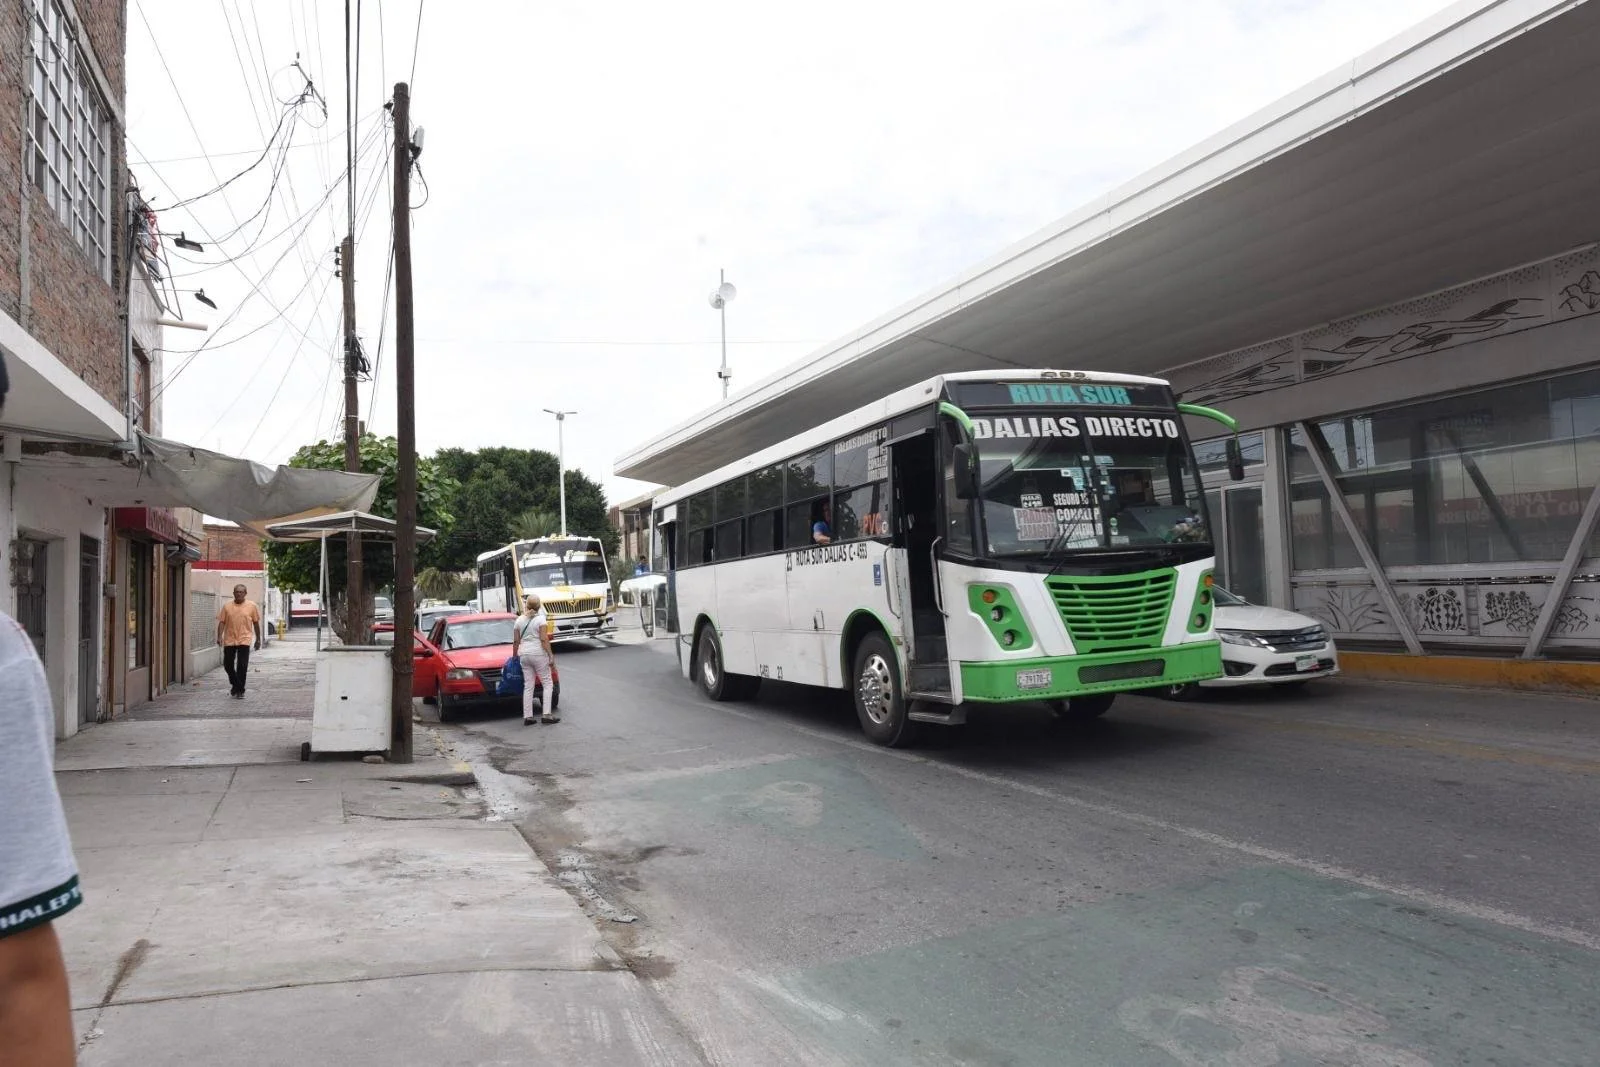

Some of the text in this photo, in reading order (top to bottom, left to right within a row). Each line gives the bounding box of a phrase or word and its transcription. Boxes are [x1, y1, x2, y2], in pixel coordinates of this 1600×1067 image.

[1008, 383, 1132, 405] RUTA SUR
[975, 417, 1179, 439] DALIAS DIRECTO
[1053, 493, 1080, 506] SEGURO
[1478, 490, 1557, 511] TMINAL
[796, 550, 811, 566] RUTA
[811, 548, 824, 564] SUR
[824, 544, 847, 563] DALIAS
